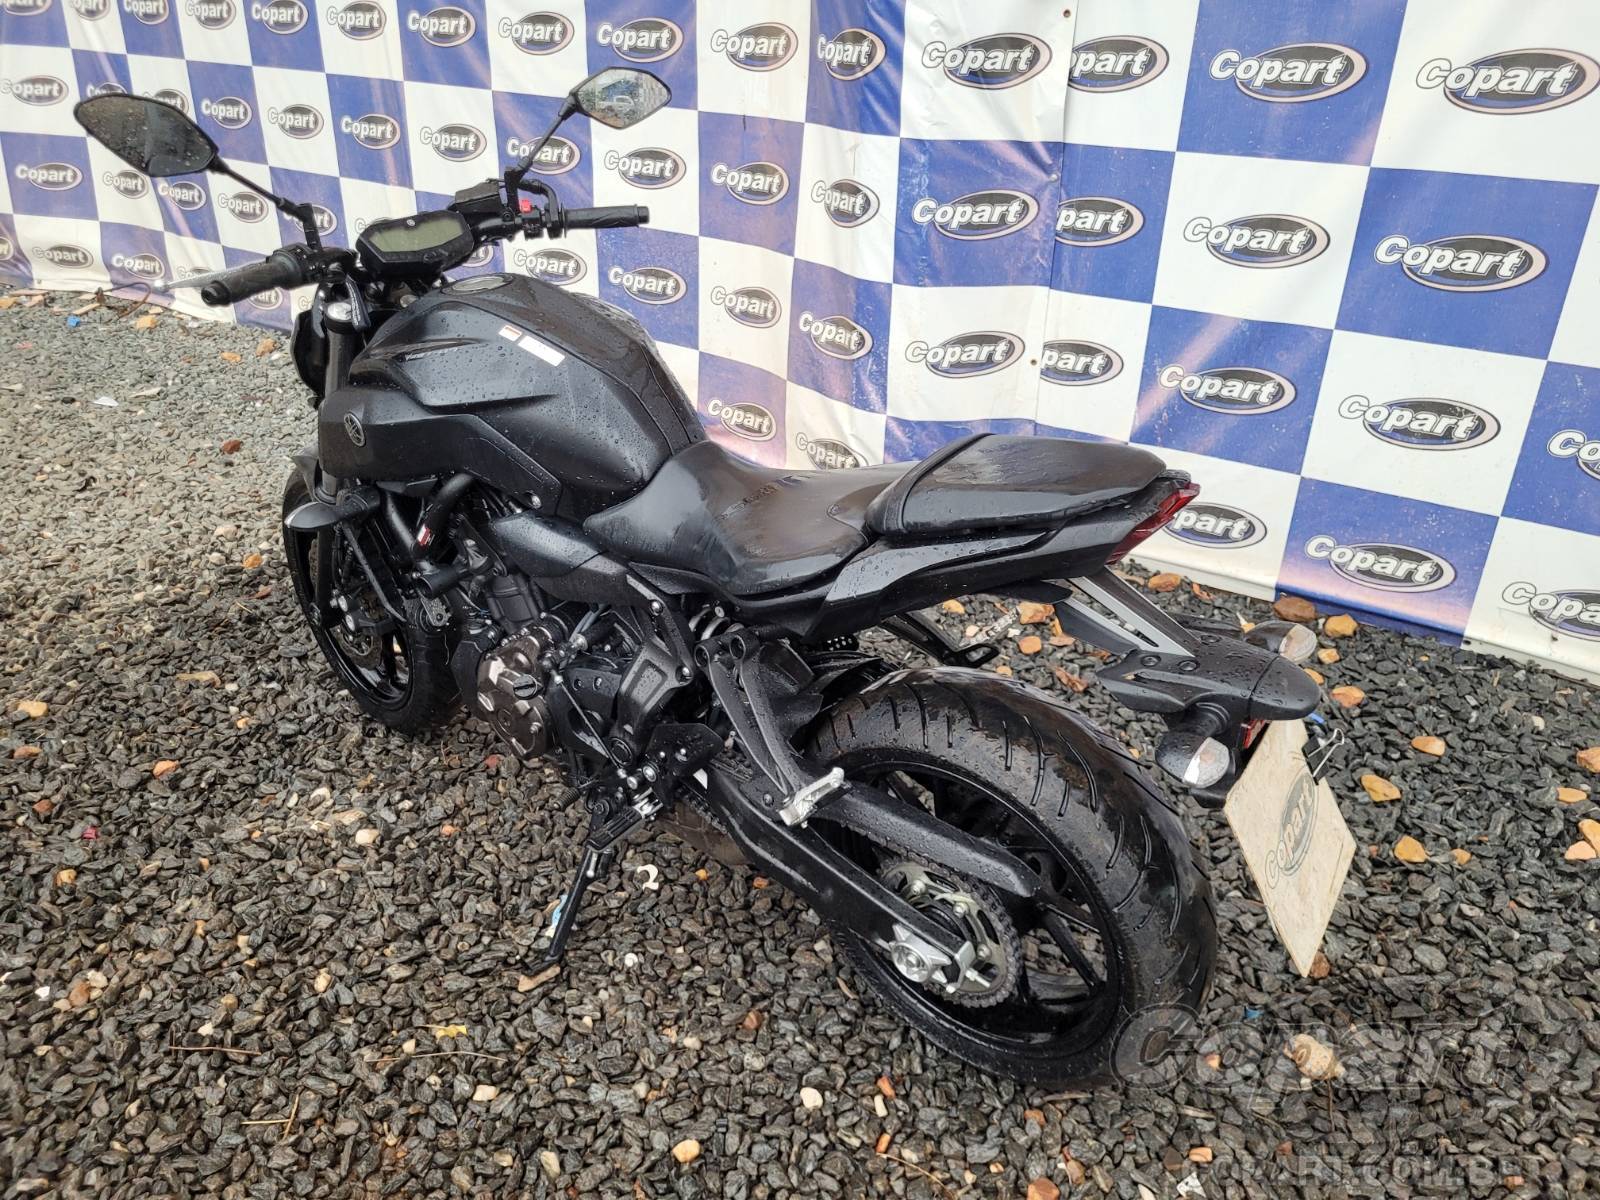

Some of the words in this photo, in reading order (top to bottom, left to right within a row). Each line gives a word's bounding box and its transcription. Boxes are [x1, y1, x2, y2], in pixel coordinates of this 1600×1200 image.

[124, 0, 164, 15] Copart
[185, 1, 229, 20] Copart
[252, 3, 300, 24] Copart
[327, 7, 381, 30] Copart
[407, 12, 468, 36] Copart
[499, 17, 565, 43] Copart
[597, 23, 672, 51] Copart
[711, 29, 789, 61] Copart
[817, 34, 873, 66] Copart
[922, 41, 1036, 73] Copart
[1071, 47, 1151, 79] part
[1209, 49, 1348, 89] Copart
[1, 79, 61, 99] Copart
[1416, 58, 1580, 98] Copart
[201, 100, 247, 121] Copart
[268, 106, 316, 131] Copart
[341, 116, 394, 140] Copart
[420, 127, 478, 154] Copart
[15, 164, 75, 182] Copart
[604, 150, 676, 177] Copart
[103, 172, 143, 192] Copart
[158, 181, 200, 202] Copart
[711, 163, 783, 195] Copart
[217, 193, 263, 216] Copart
[811, 180, 867, 216] Copart
[912, 198, 1026, 228] Copart
[1056, 207, 1129, 234] part
[1183, 217, 1310, 255] Copart
[32, 247, 85, 263] Copart
[111, 254, 162, 273] Copart
[514, 249, 578, 276] Copart
[1374, 236, 1527, 278] Copart
[609, 265, 676, 296] Copart
[710, 286, 776, 317] Copart
[799, 311, 863, 350] Copart
[905, 338, 1013, 366] Copart
[1041, 349, 1108, 376] part
[1159, 364, 1281, 406] Copart
[708, 399, 772, 433] Copart
[1338, 395, 1483, 440] Copart
[796, 432, 856, 468] Copart
[1172, 509, 1250, 539] part
[1305, 535, 1438, 589] Copart
[1502, 581, 1600, 624] Copa
[1265, 777, 1314, 889] Copart
